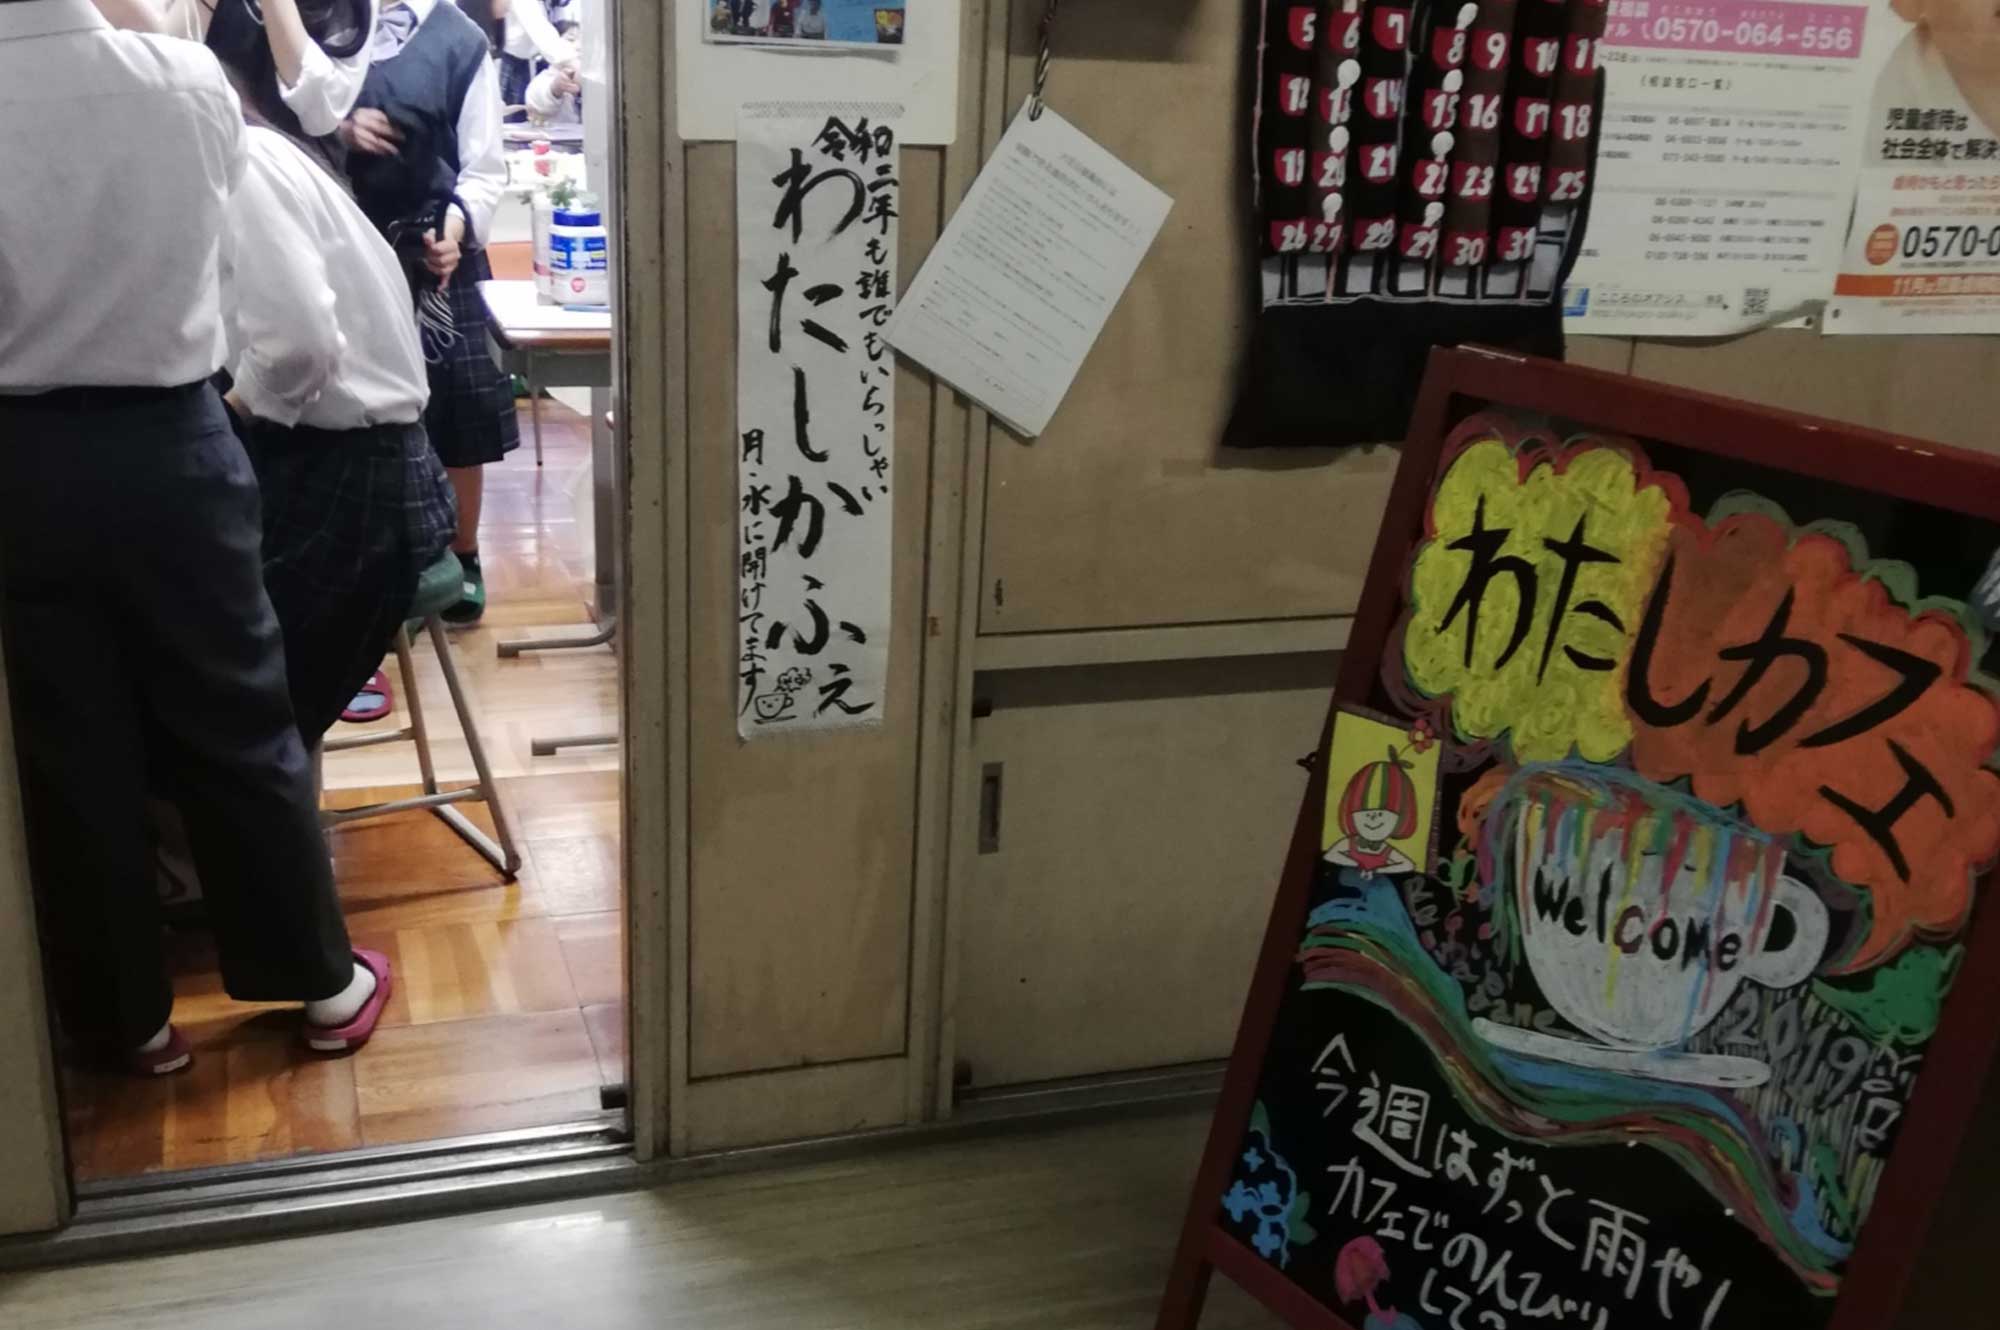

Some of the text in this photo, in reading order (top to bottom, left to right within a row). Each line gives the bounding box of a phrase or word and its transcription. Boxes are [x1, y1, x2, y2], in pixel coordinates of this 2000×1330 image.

[1302, 12, 1317, 42] 5
[1342, 15, 1360, 49] 6
[1387, 13, 1405, 44] 7
[1447, 32, 1466, 64] 8
[1486, 32, 1506, 69] 9
[1653, 17, 1853, 50] 0570-064-556
[1470, 94, 1500, 129] 16
[1561, 104, 1592, 140] 18
[1459, 165, 1494, 196] 23
[1453, 237, 1485, 266] 30
